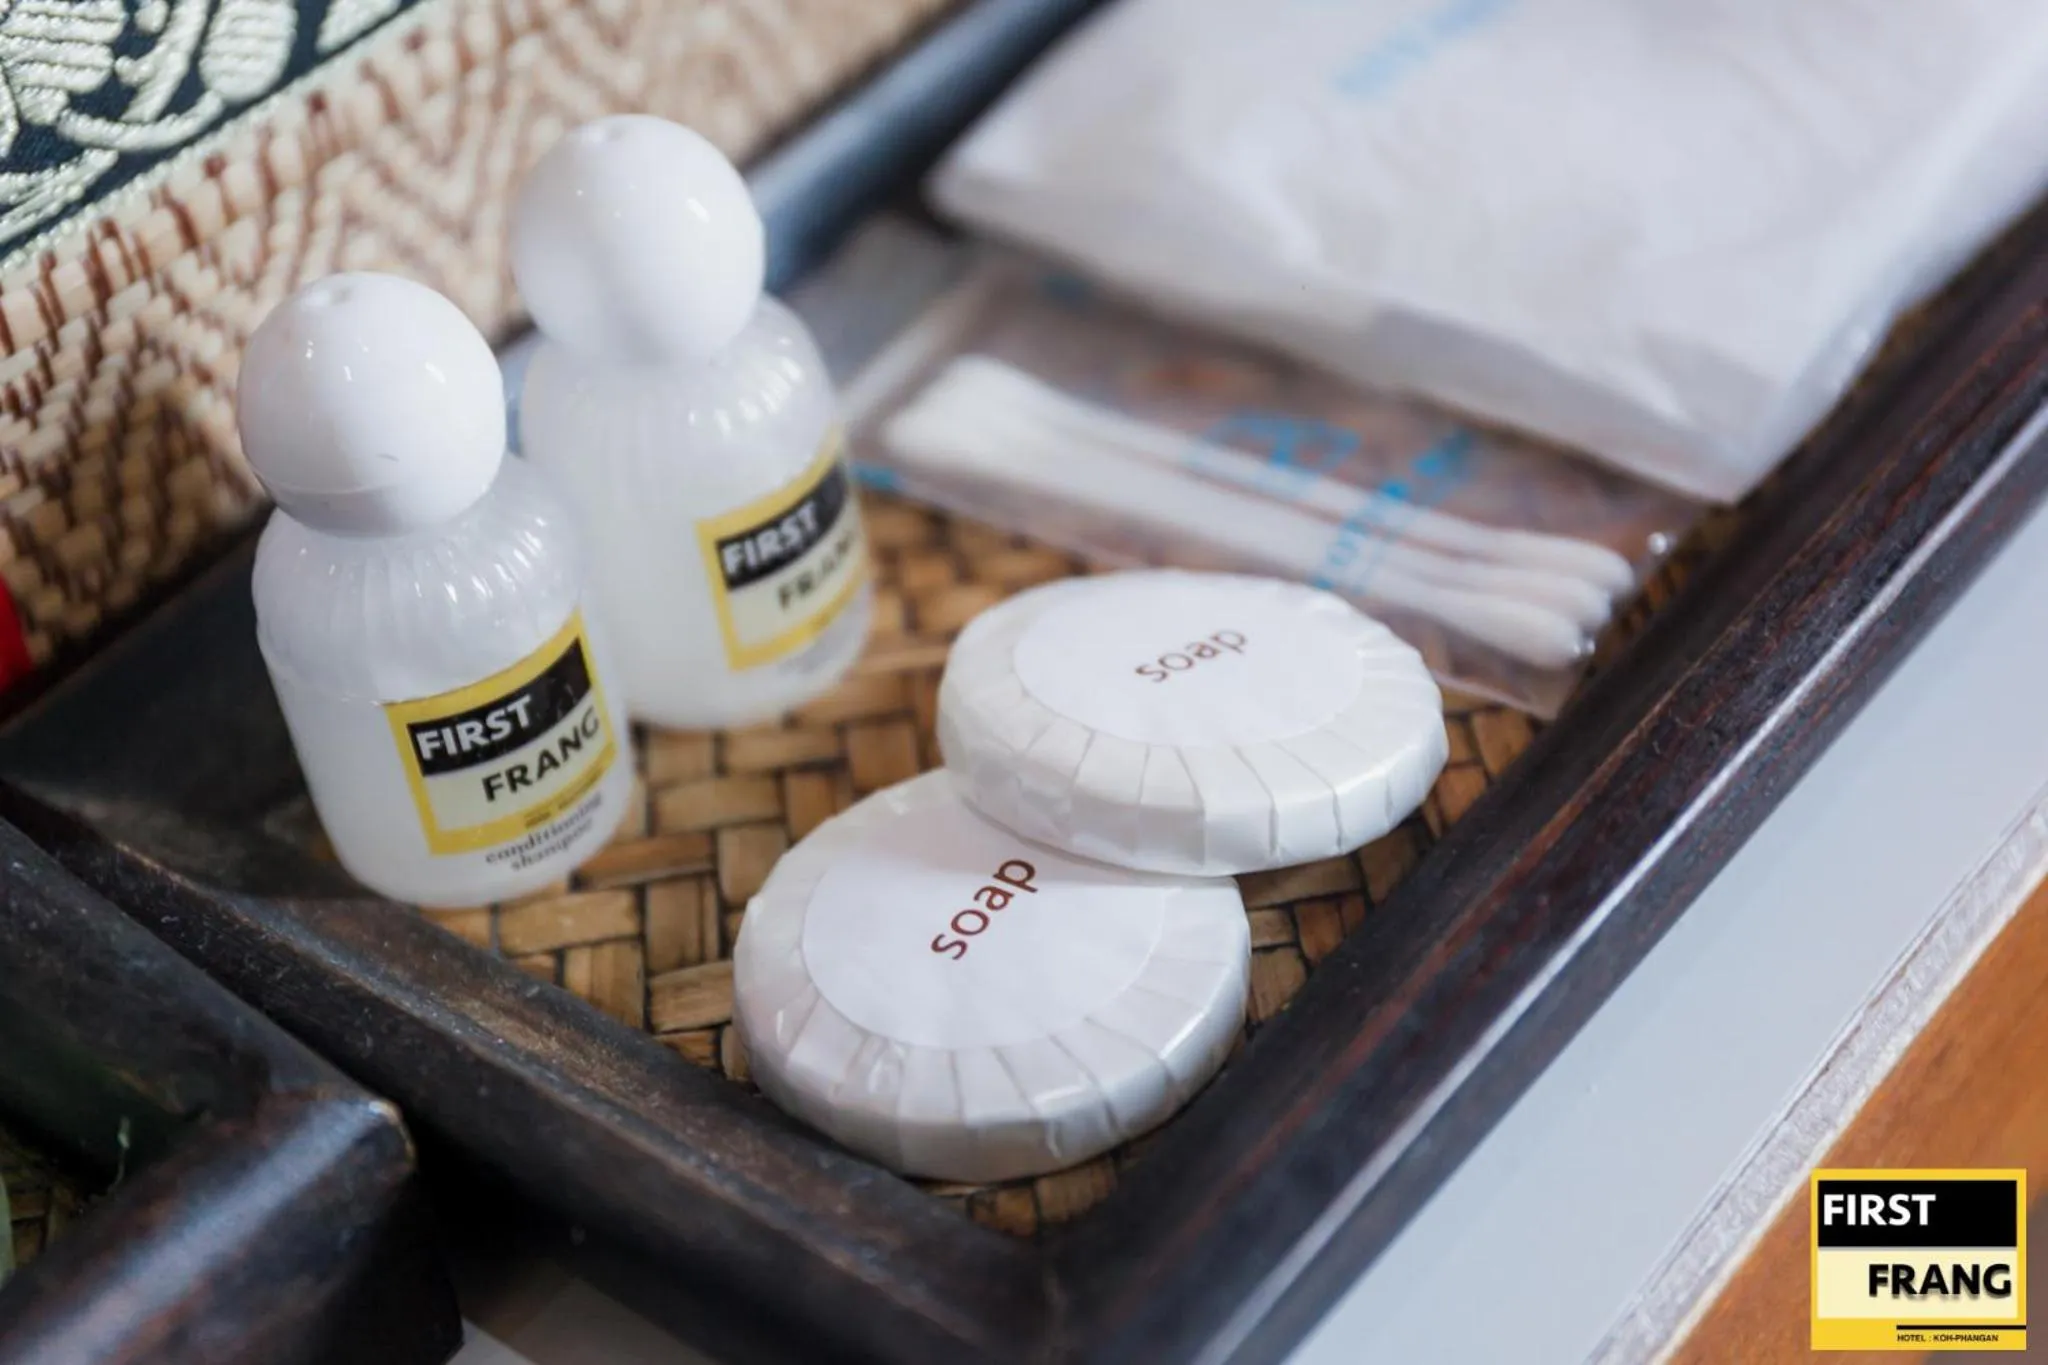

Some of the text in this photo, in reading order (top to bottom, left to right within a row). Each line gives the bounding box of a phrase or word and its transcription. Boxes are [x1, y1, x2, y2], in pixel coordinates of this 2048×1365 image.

[722, 501, 818, 577] FIRST
[1135, 629, 1248, 683] soap
[415, 695, 532, 760] FIRST
[481, 706, 600, 802] FRANG
[931, 859, 1038, 960] soap
